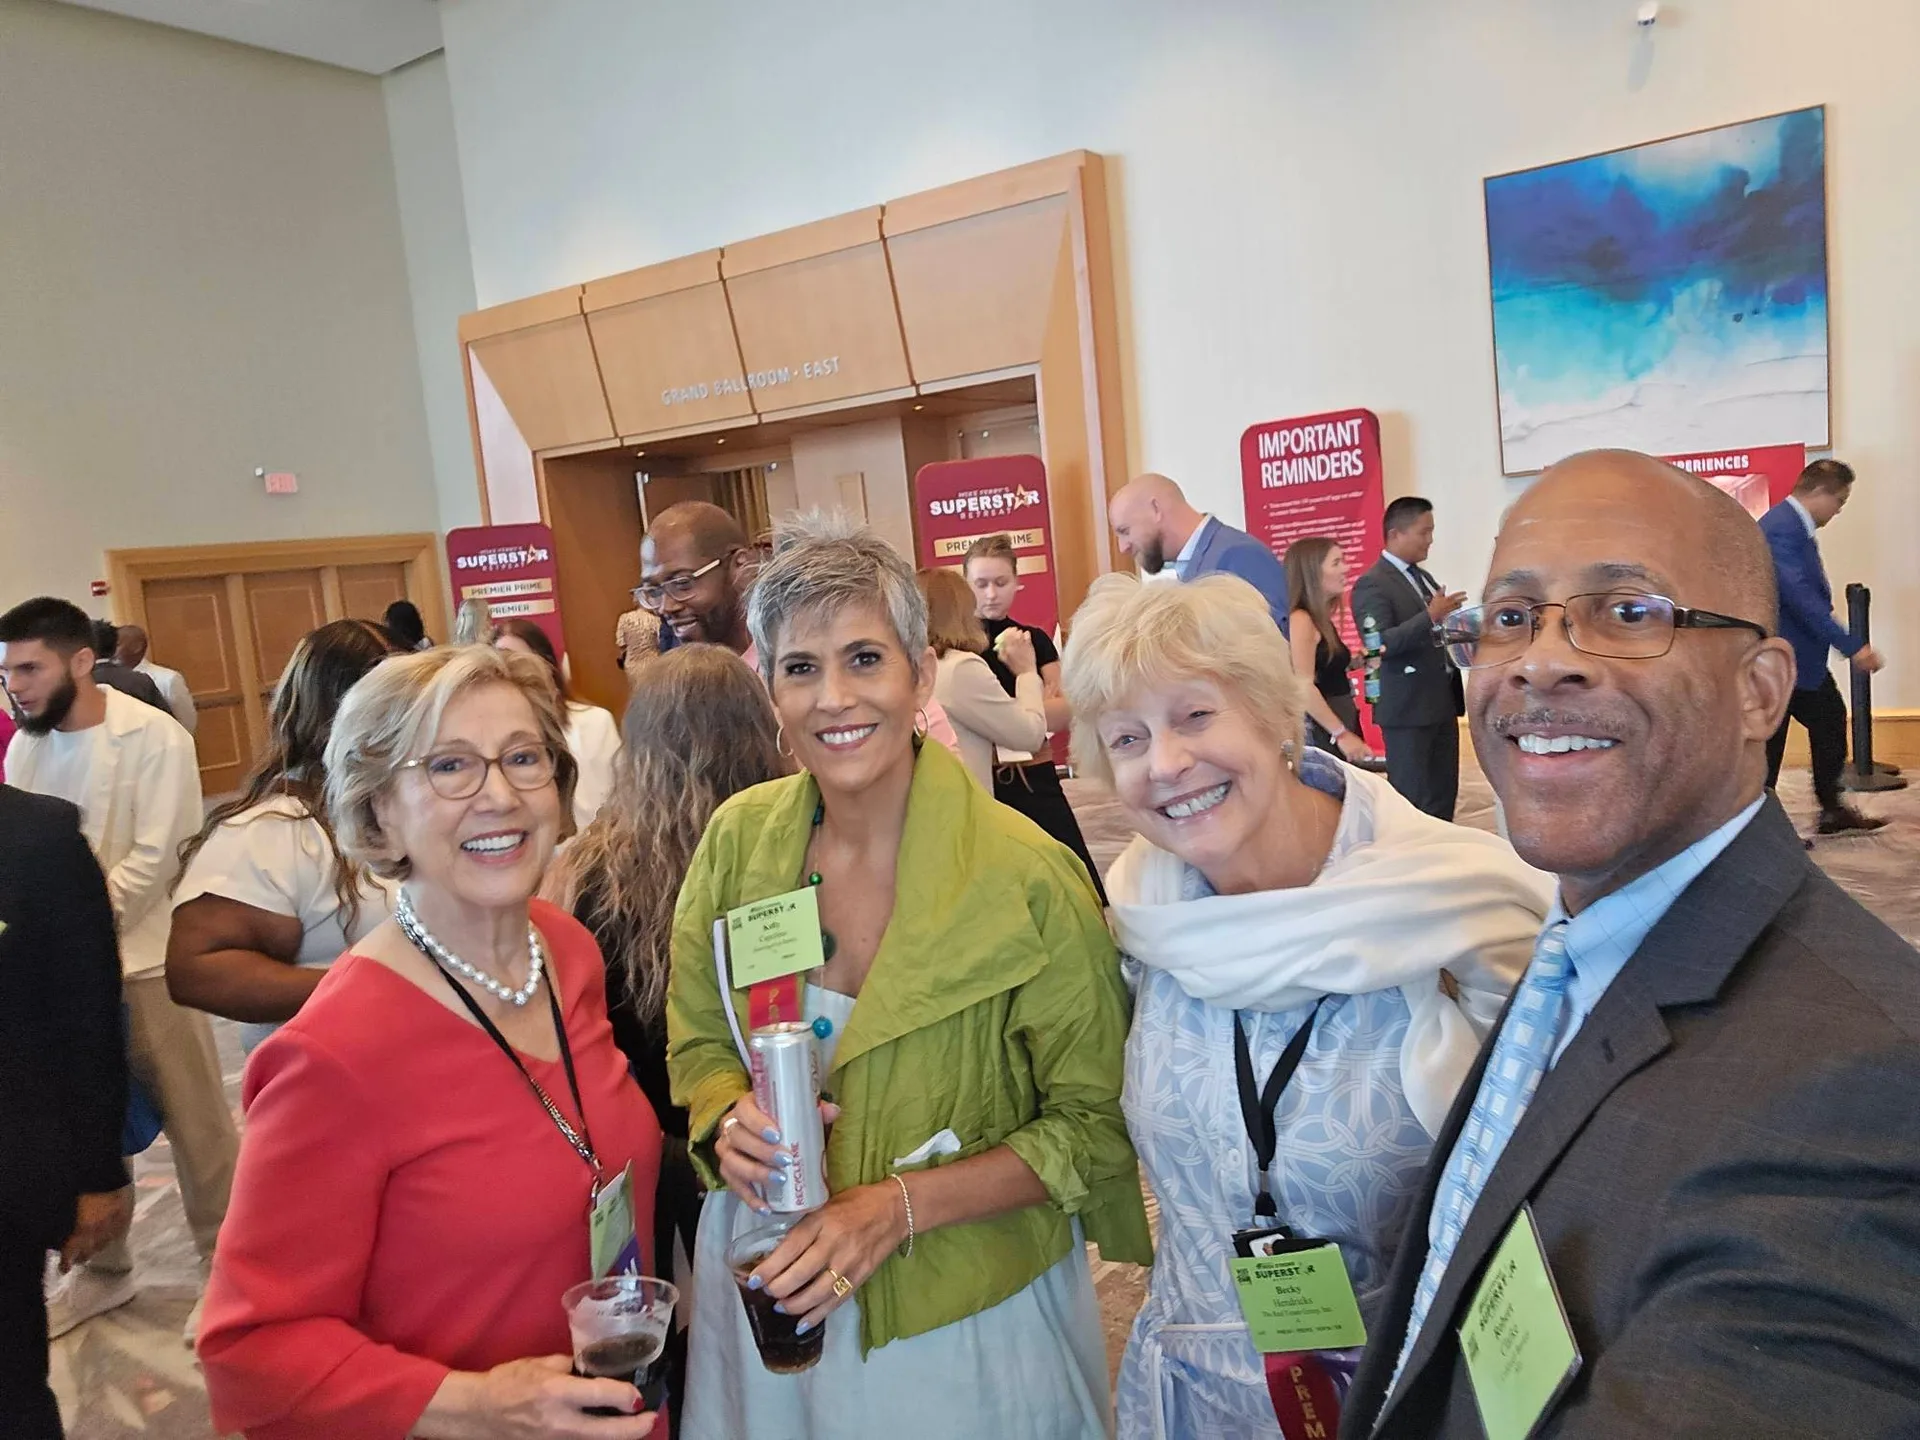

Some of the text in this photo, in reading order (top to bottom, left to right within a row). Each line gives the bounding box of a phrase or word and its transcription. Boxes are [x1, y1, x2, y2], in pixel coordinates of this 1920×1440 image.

[661, 356, 840, 406] GRAND BALLROOM EAST
[1258, 418, 1363, 459] IMPORTANT
[1261, 449, 1364, 489] REMINDERS
[1672, 454, 1749, 473] PERIENCES
[471, 581, 542, 596] PREMIER PRIME
[490, 604, 530, 615] PREMIER
[1255, 1264, 1316, 1279] SUPERSTR
[1275, 1285, 1302, 1295] Becky
